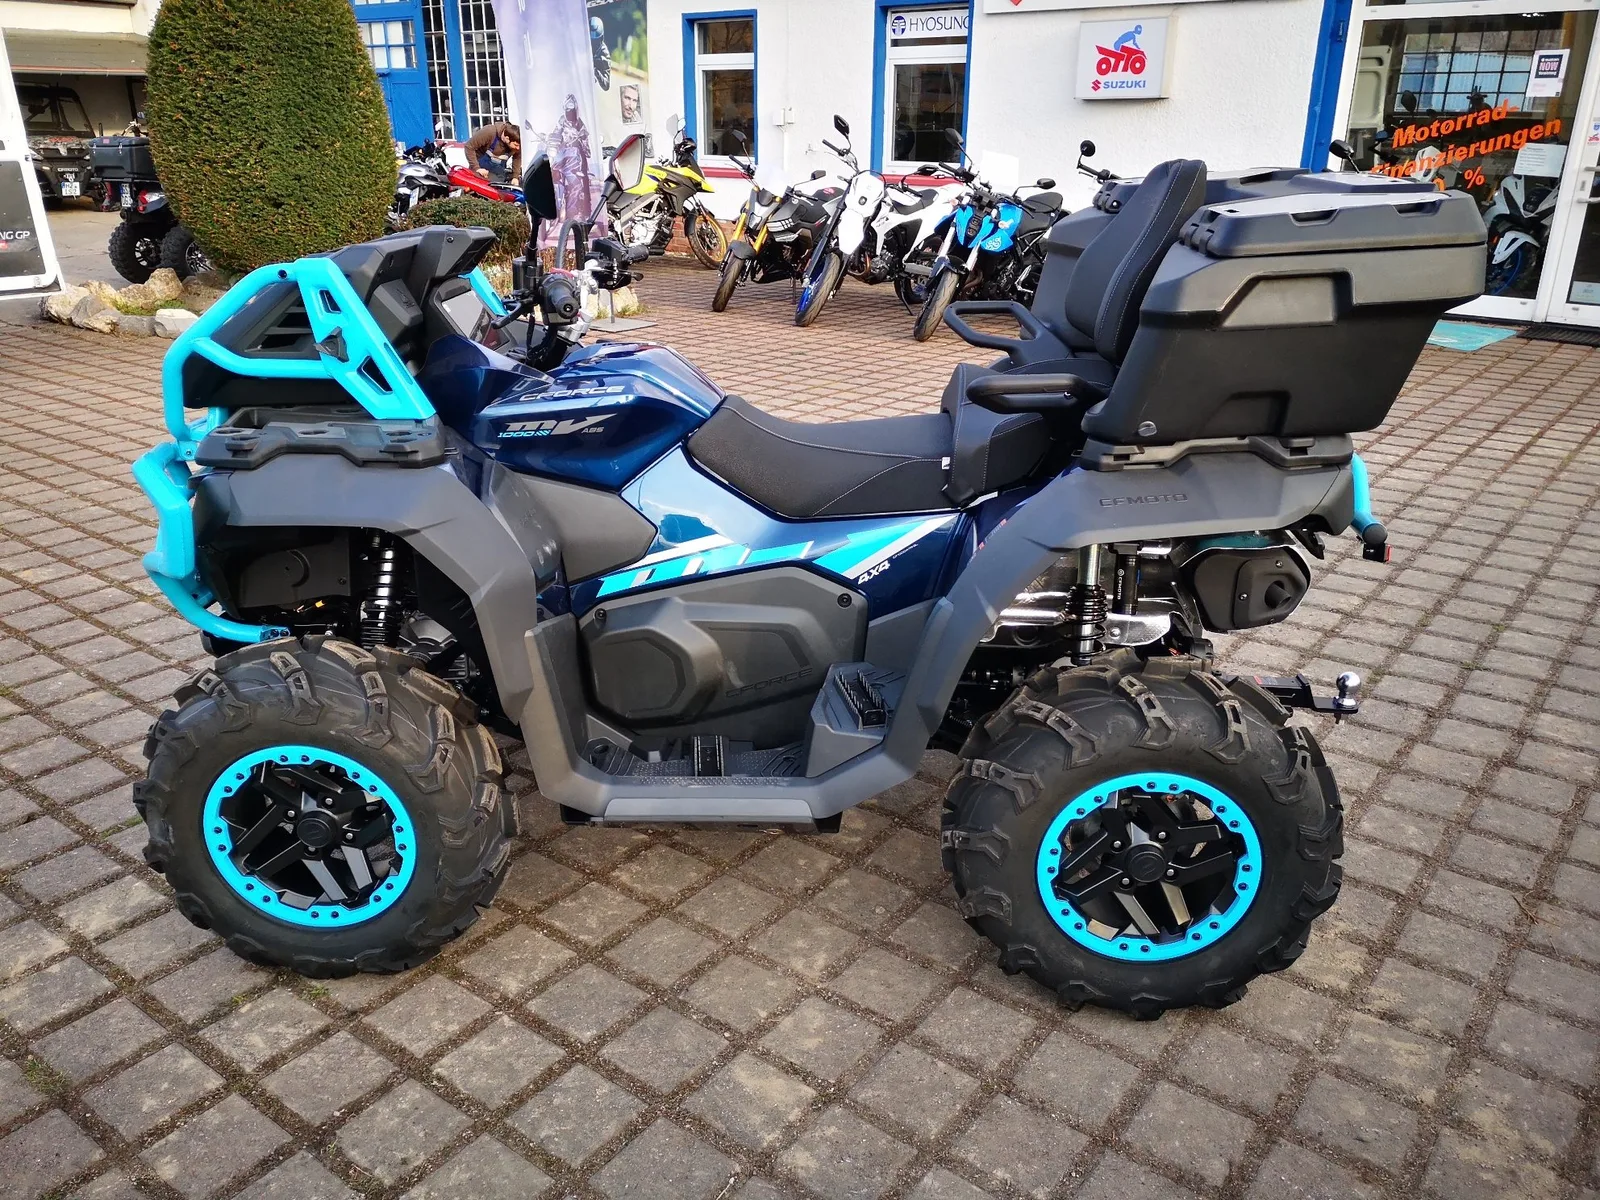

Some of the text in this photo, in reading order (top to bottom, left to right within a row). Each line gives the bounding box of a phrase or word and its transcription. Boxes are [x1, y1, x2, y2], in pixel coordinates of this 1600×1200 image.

[1103, 80, 1146, 89] SUZUKI
[15, 230, 30, 240] GP
[519, 385, 625, 401] CFORCE
[497, 430, 536, 438] 1000
[581, 426, 605, 434] ABS
[1099, 493, 1189, 508] CFMOTO
